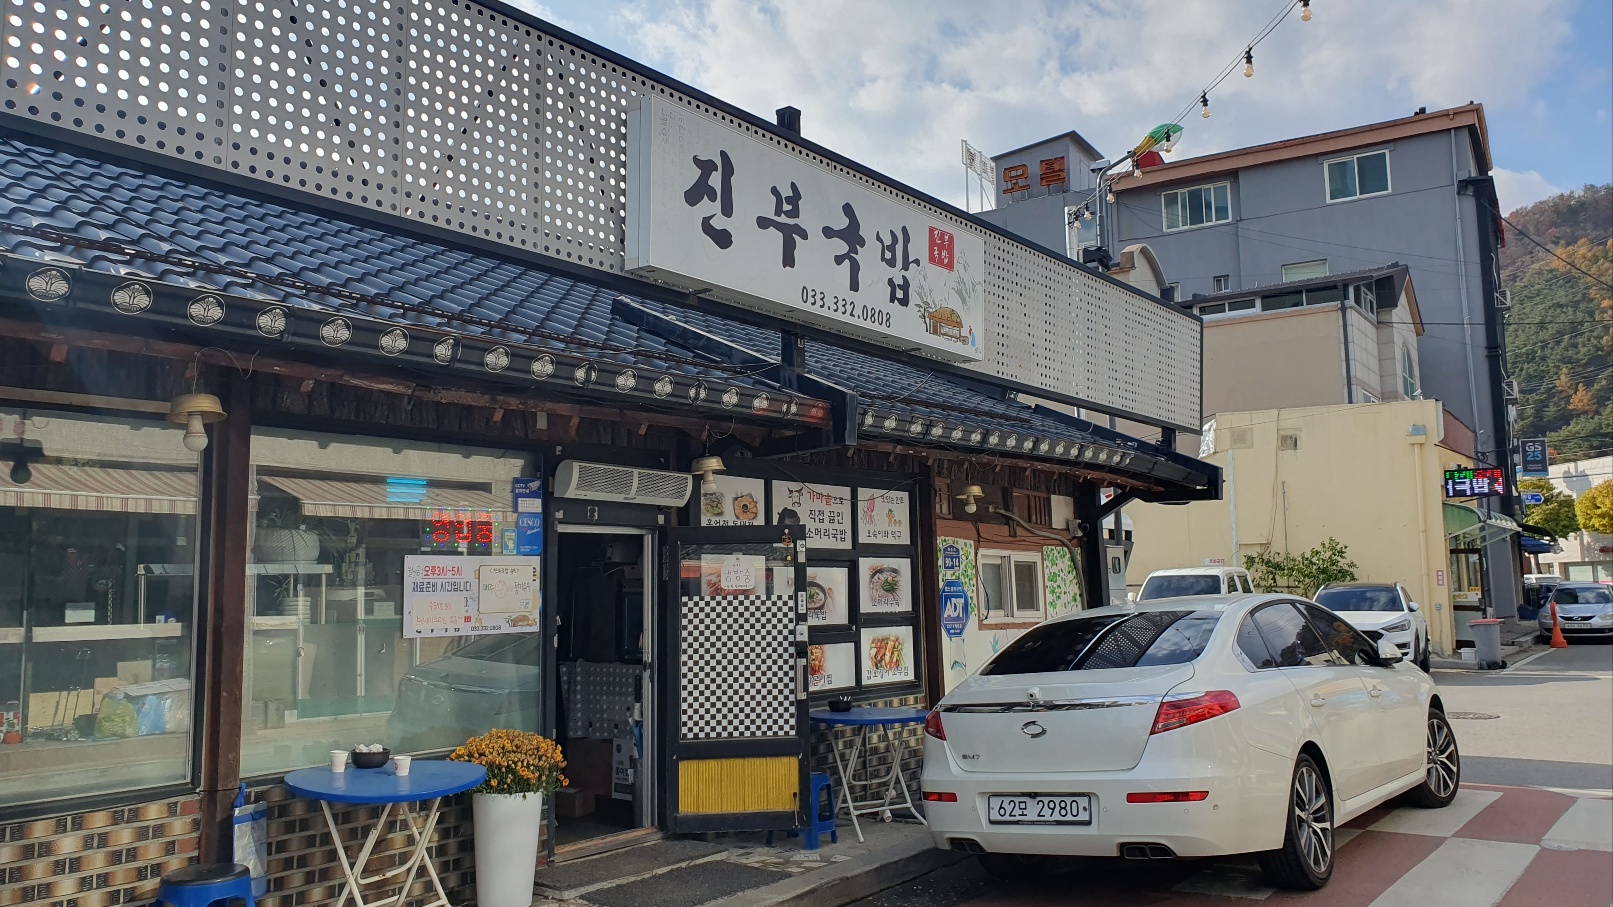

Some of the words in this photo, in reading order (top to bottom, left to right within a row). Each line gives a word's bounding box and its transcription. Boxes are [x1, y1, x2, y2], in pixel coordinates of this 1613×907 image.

[683, 150, 921, 307] 진부국밥
[933, 246, 950, 265] 국밥
[801, 285, 892, 329] 033.332.0808
[1525, 442, 1542, 451] GS
[1527, 452, 1542, 461] 25
[519, 517, 540, 527] CESCO
[808, 509, 825, 524] 직접
[432, 511, 493, 543] 영업중
[806, 528, 847, 543] 소머리국밥
[424, 565, 463, 577] 오후3시~5시
[723, 568, 751, 583] 냉방중
[412, 581, 437, 593] 재료준비
[944, 597, 965, 618] ADT
[1036, 799, 1080, 818] 2980
